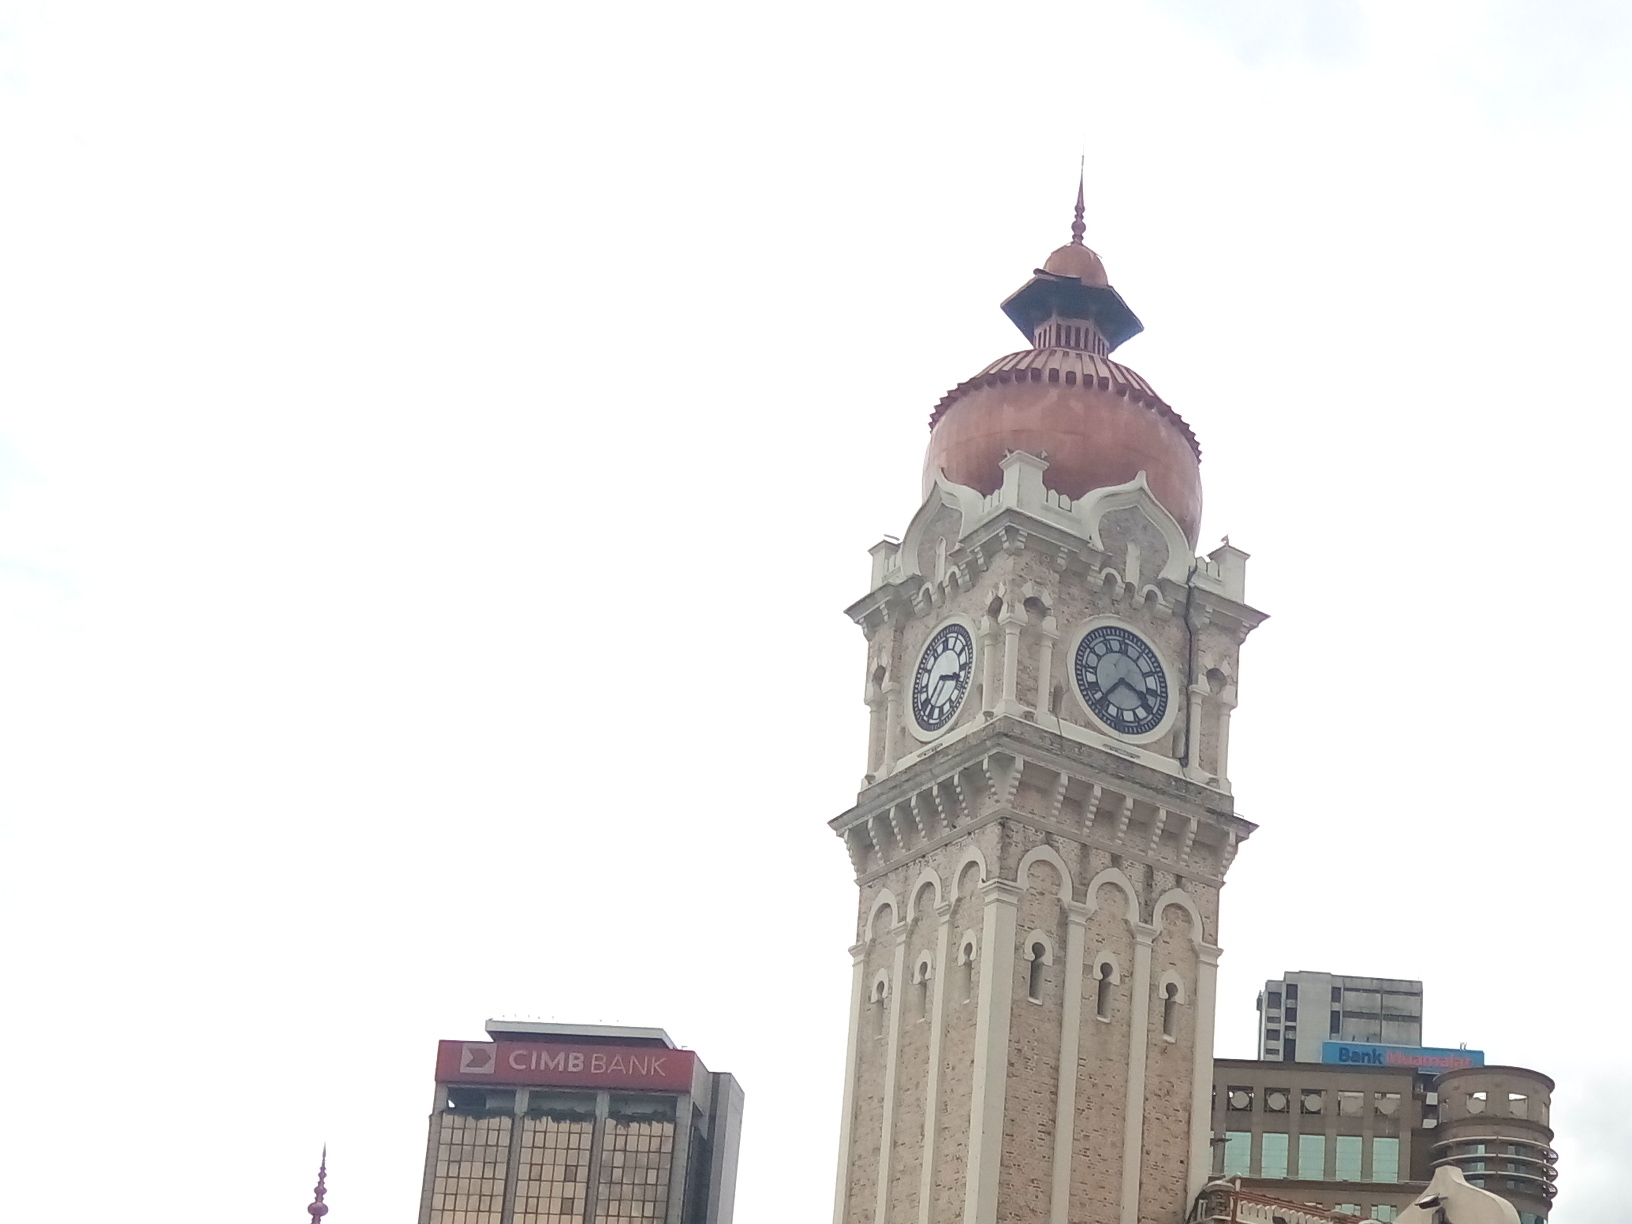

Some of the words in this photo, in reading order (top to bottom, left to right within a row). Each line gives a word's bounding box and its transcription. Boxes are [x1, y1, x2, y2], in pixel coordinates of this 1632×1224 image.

[508, 1050, 584, 1072] CIMB
[591, 1053, 667, 1077] BANK
[1338, 1047, 1383, 1064] Bank
